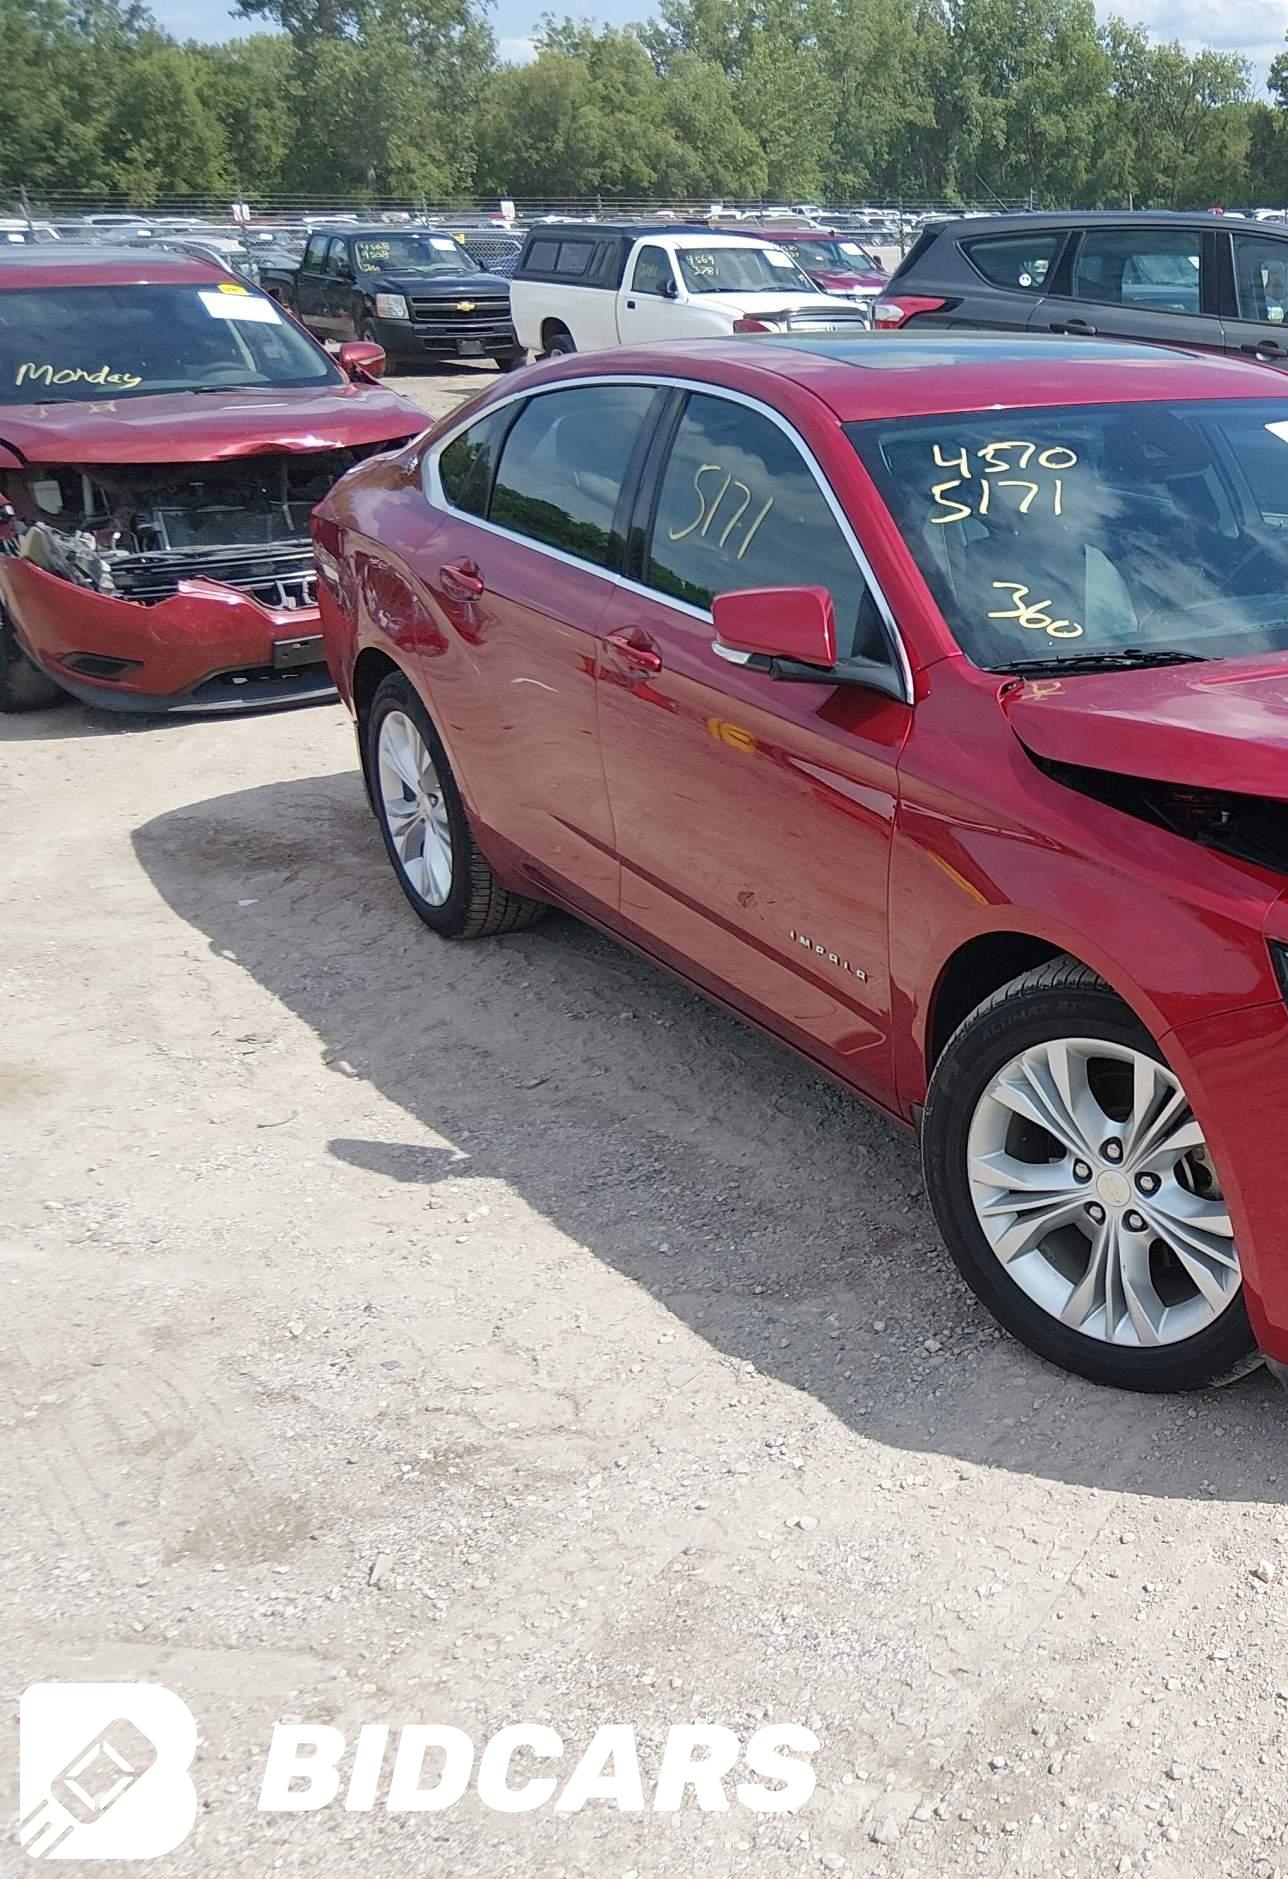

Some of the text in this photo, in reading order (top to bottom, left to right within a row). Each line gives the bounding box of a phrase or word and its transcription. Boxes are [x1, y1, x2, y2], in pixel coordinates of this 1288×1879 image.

[15, 362, 143, 390] Monday
[932, 440, 1078, 479] 4570
[668, 463, 775, 560] 5171
[930, 478, 1062, 524] 5171
[987, 581, 1084, 638] 360
[789, 928, 868, 984] IMPALA
